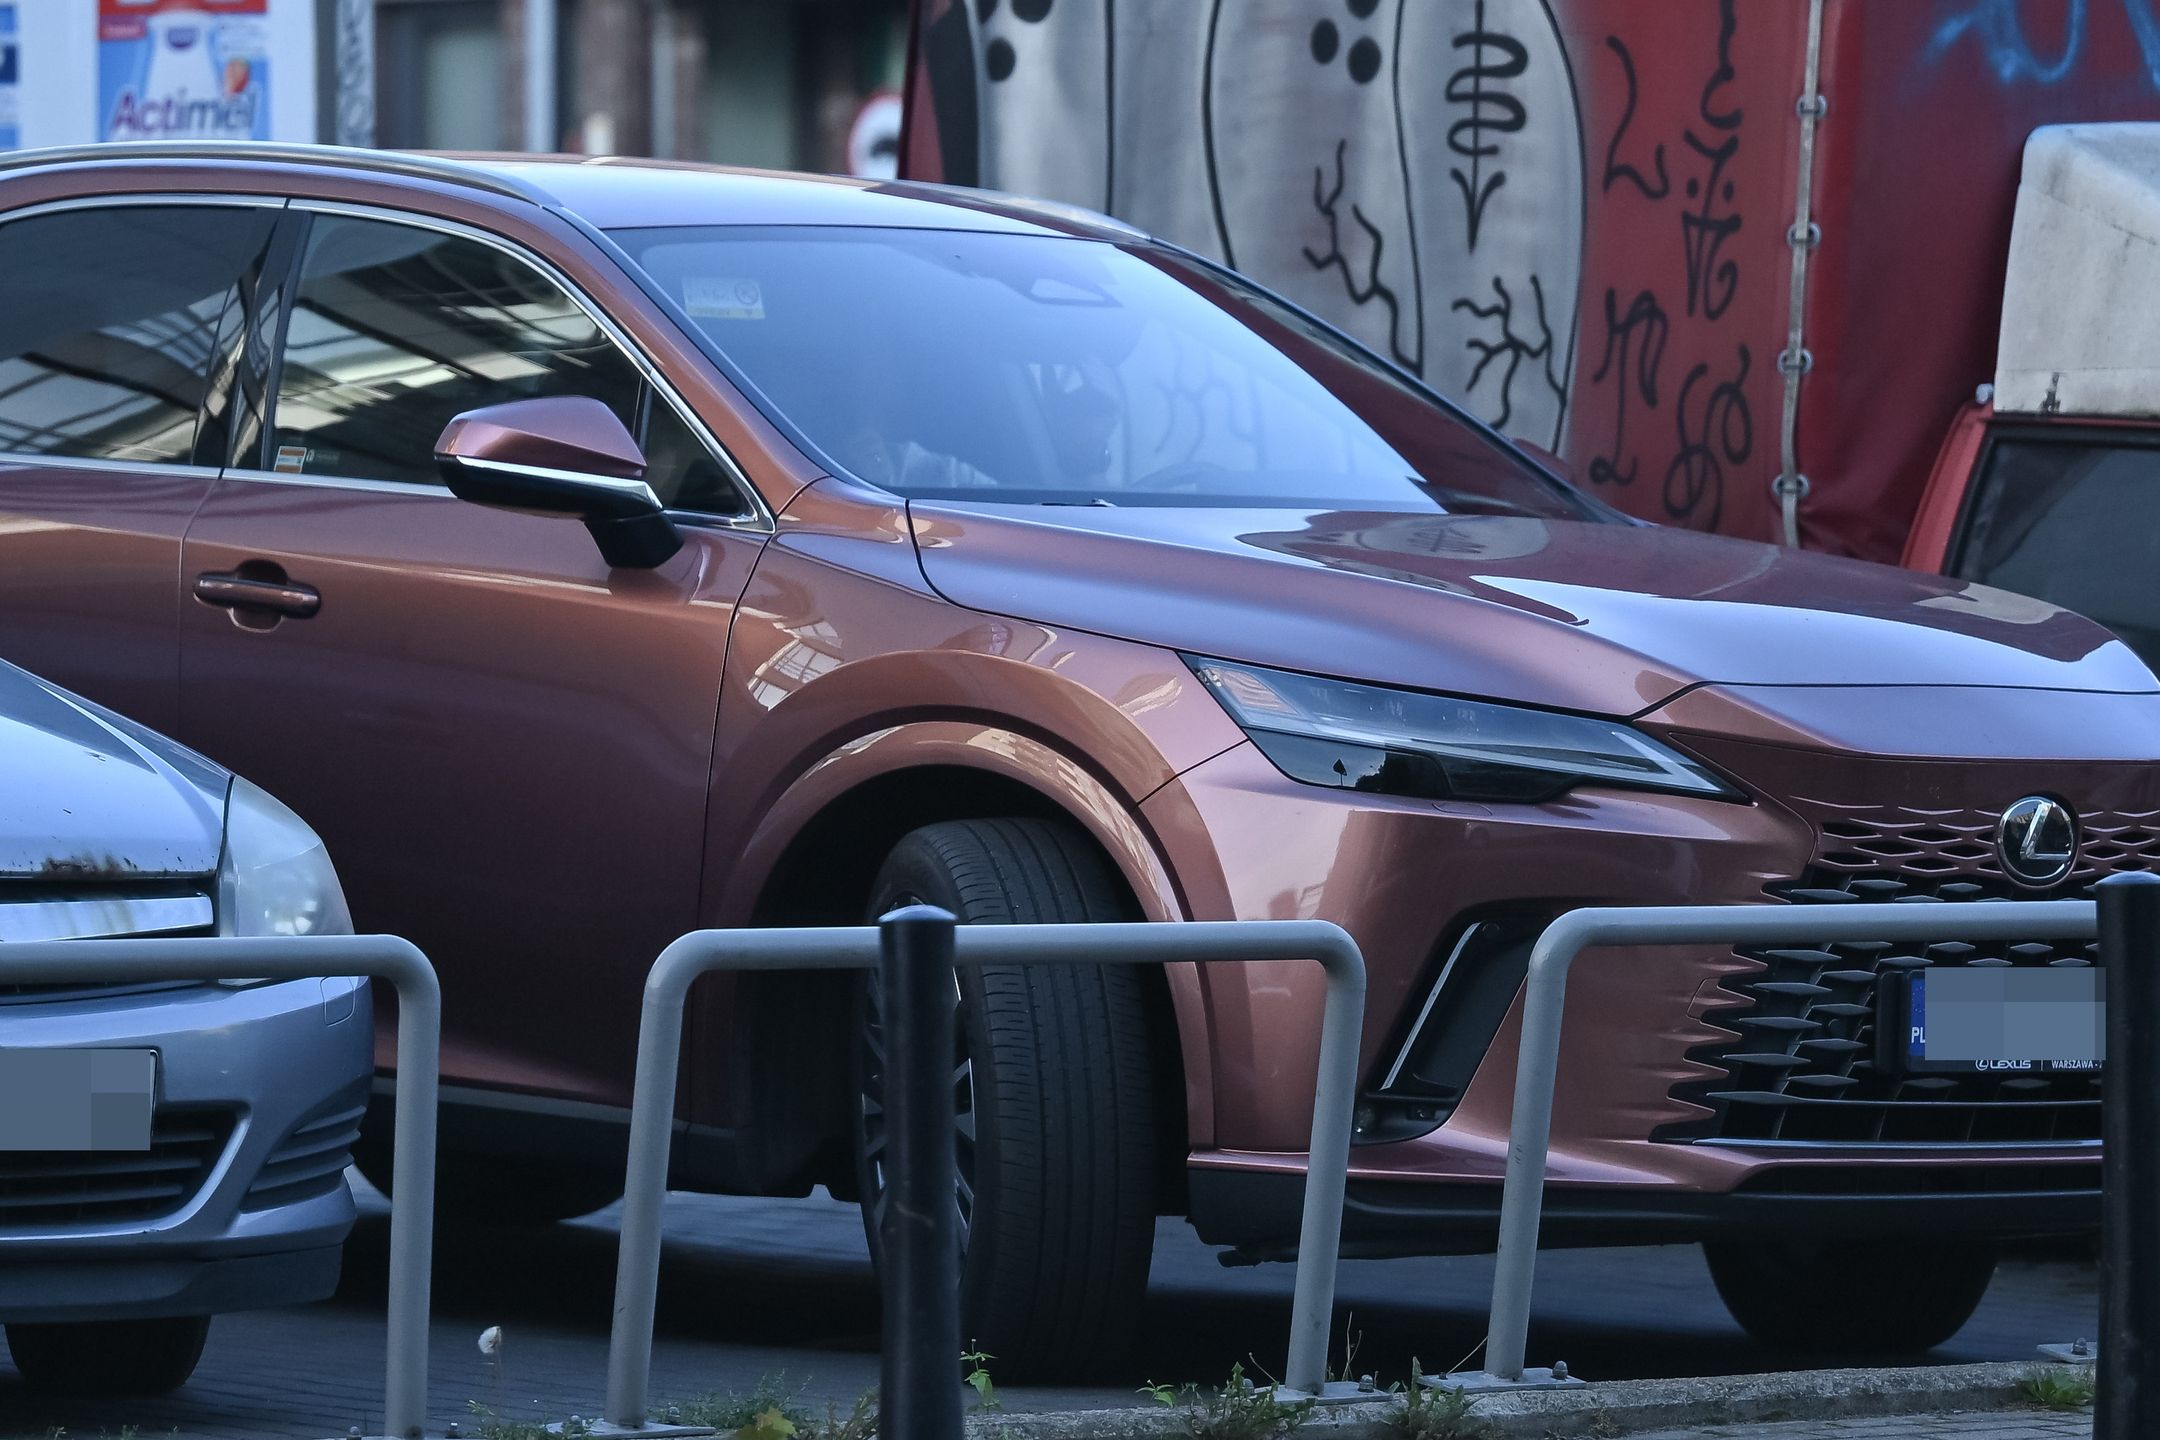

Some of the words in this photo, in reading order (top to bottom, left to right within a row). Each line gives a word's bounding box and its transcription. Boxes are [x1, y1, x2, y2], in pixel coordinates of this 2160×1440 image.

[112, 87, 257, 134] Actimel
[1911, 1026, 1926, 1044] PL
[1990, 1059, 2032, 1069] LEXUS
[2051, 1059, 2094, 1069] WARSZAWA
